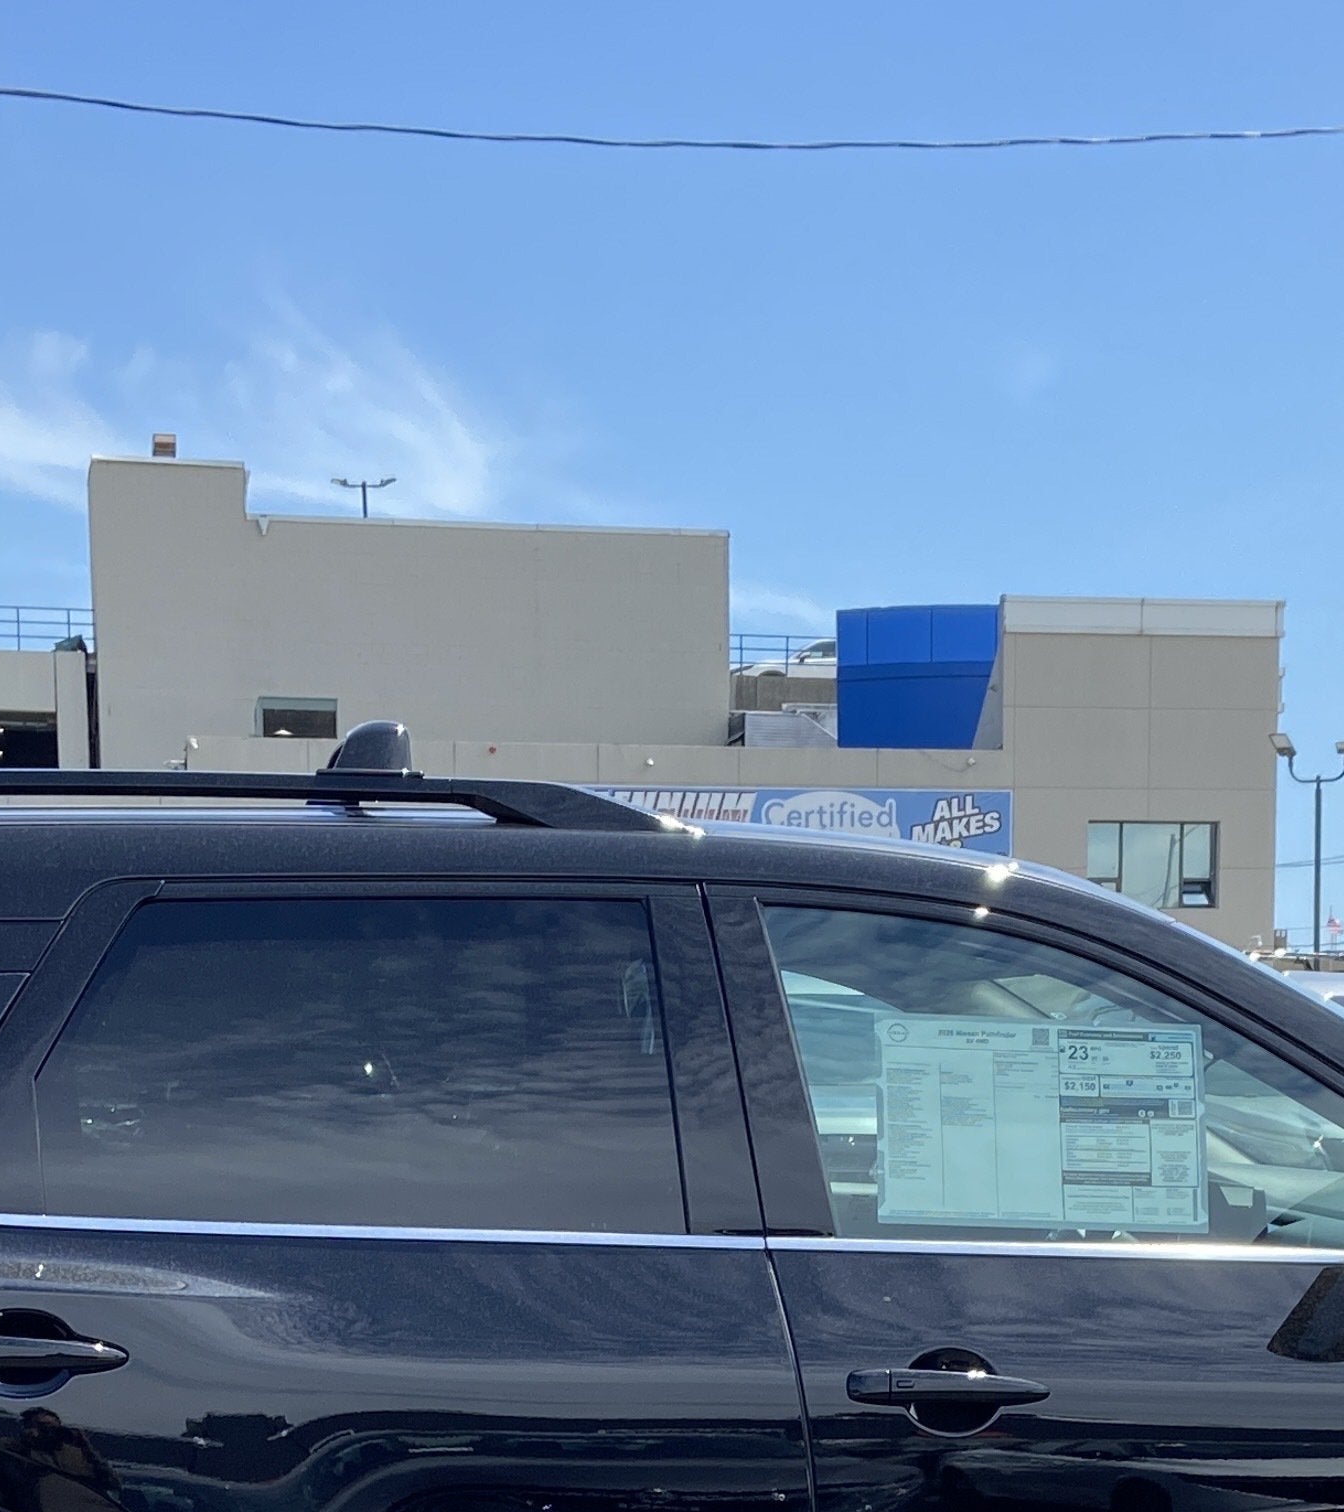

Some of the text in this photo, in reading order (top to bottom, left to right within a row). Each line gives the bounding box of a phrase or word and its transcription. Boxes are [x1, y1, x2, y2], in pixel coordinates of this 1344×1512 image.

[764, 802, 894, 828] Certified
[933, 794, 980, 822] ALL
[910, 810, 1002, 844] MAKES
[1068, 1045, 1089, 1060] 23
